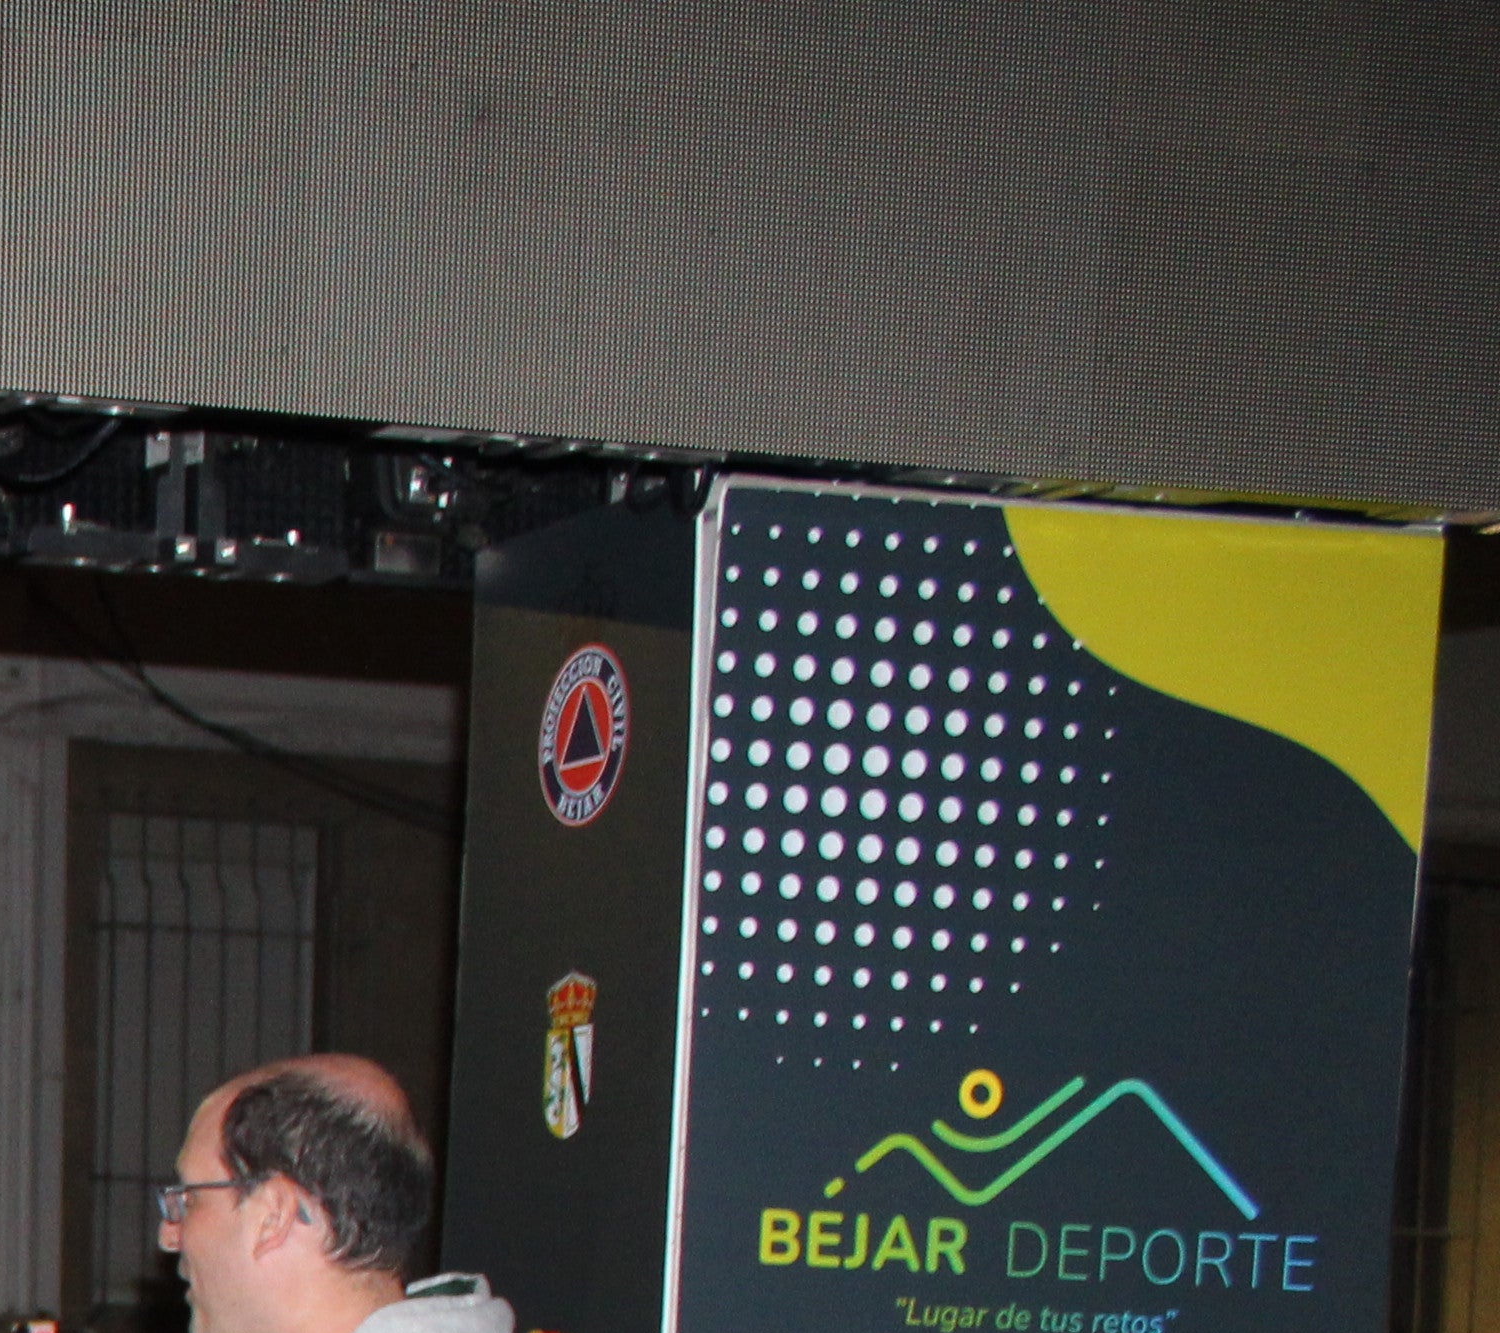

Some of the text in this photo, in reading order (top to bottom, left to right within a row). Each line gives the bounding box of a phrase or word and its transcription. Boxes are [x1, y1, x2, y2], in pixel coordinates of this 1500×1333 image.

[1006, 1222, 1316, 1291] DEPORTE
[995, 1302, 1031, 1332] de
[1040, 1306, 1083, 1333] tus
